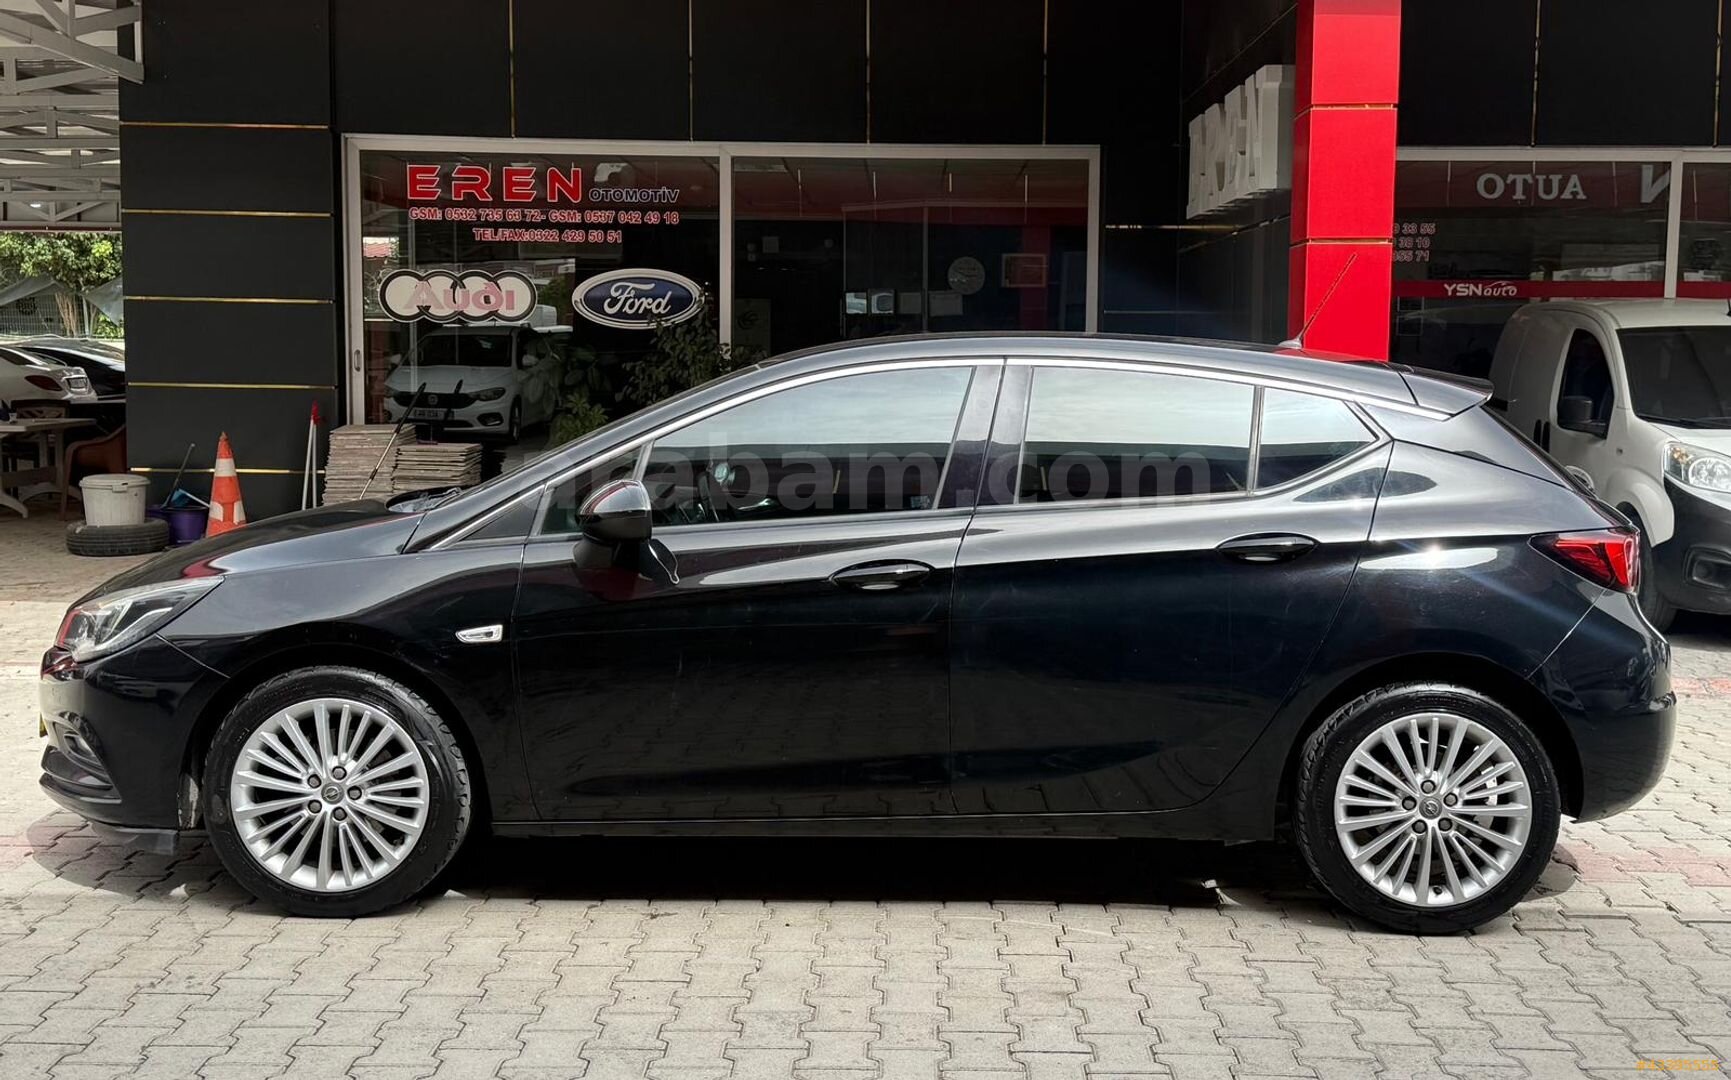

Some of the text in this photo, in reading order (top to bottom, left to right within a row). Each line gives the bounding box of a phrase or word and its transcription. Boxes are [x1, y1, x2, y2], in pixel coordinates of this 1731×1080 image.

[407, 164, 680, 203] EREN OTOMOTİV
[408, 206, 442, 220] GSM:
[445, 207, 477, 220] 0532
[479, 208, 503, 221] 735
[548, 209, 581, 222] GSM:
[618, 211, 642, 224] 042
[645, 211, 660, 224] 49
[663, 211, 680, 225] 18
[607, 230, 623, 243] 51
[603, 281, 672, 315] Ford
